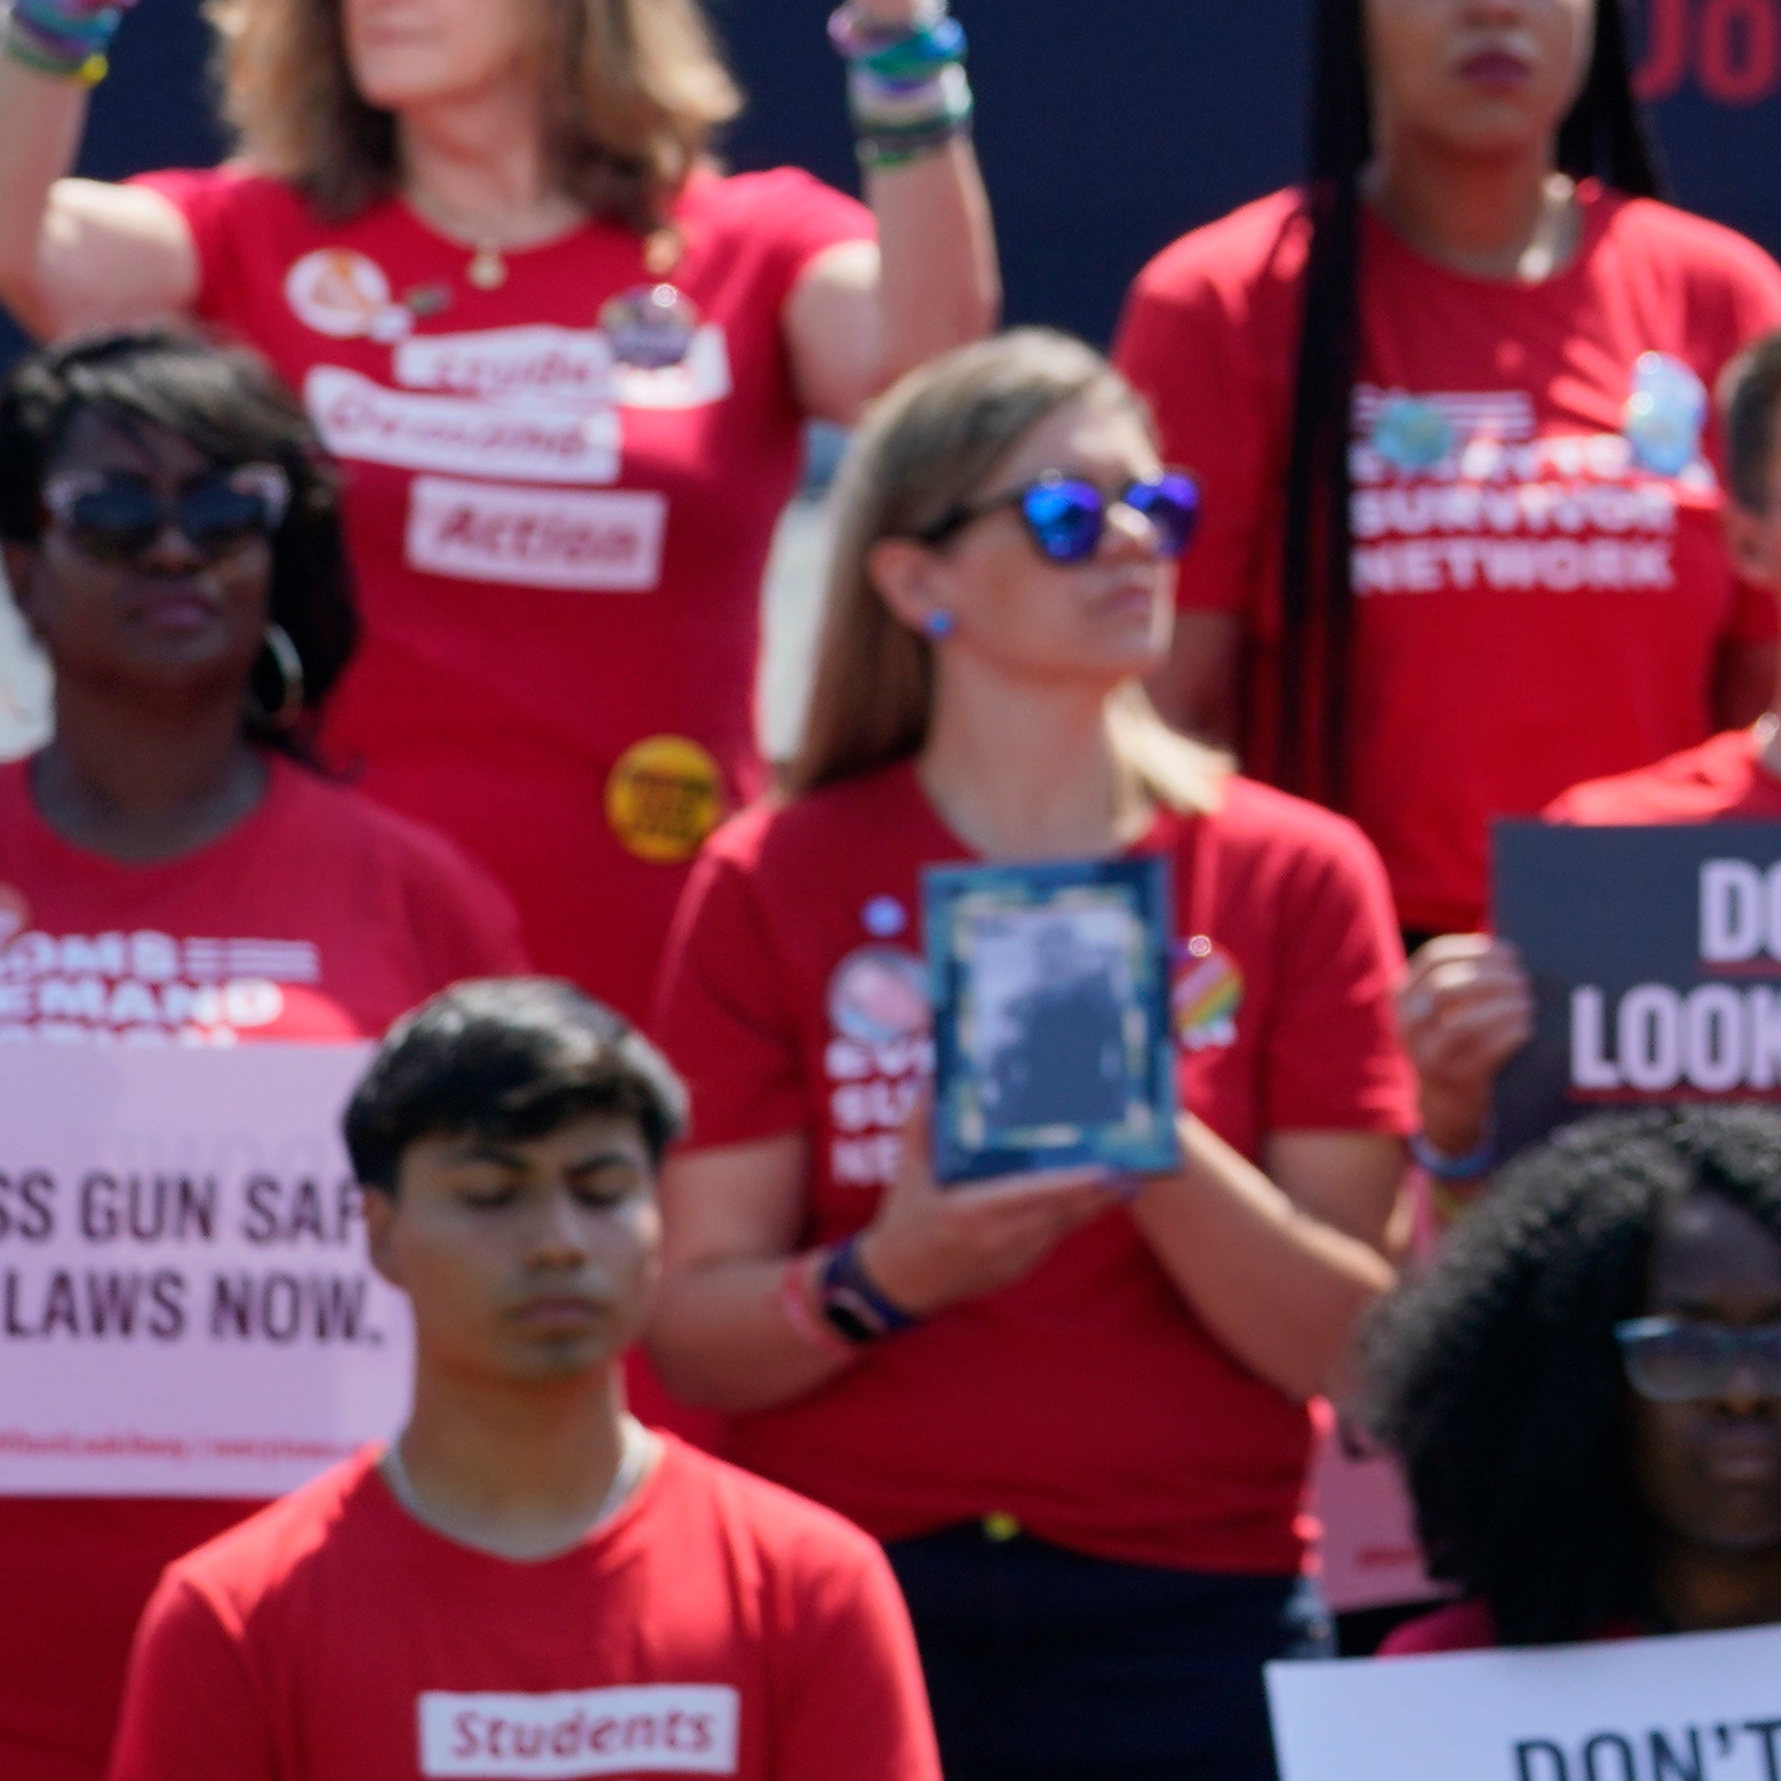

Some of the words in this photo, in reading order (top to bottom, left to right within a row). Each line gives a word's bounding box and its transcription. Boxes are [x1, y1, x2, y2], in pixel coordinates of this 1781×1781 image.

[1353, 481, 1673, 539] SURVIVOR
[1353, 537, 1675, 595] NETWORK
[80, 1172, 216, 1243] GUN
[245, 1175, 364, 1244] SAF
[3, 1269, 184, 1340] LAWS
[209, 1272, 383, 1349] NOW.
[453, 1708, 714, 1759] Students
